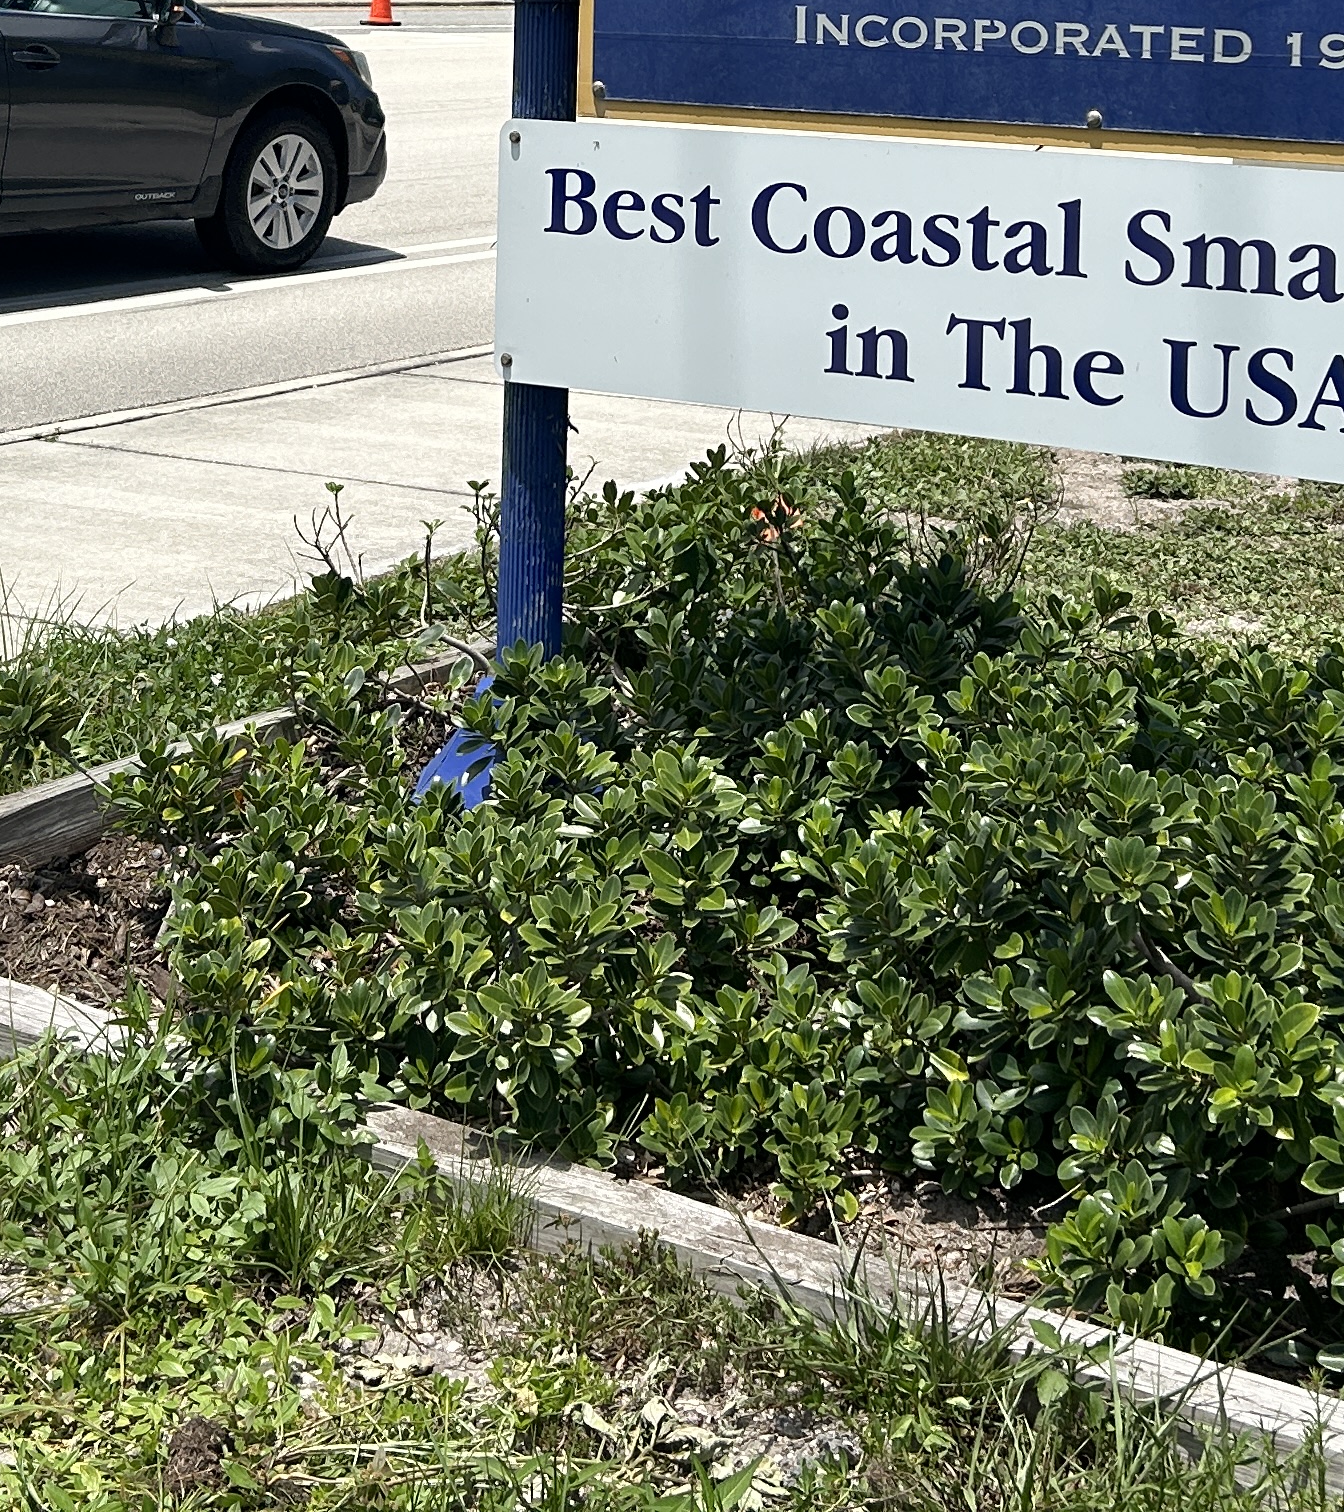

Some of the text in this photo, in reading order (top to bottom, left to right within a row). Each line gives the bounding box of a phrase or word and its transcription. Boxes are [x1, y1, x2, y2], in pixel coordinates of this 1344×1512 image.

[794, 4, 1252, 65] INCORPORATED
[135, 191, 175, 201] OUTBACK
[544, 167, 720, 248] Best
[750, 181, 1086, 280] Coastal
[825, 303, 915, 383] in
[946, 315, 1125, 407] The
